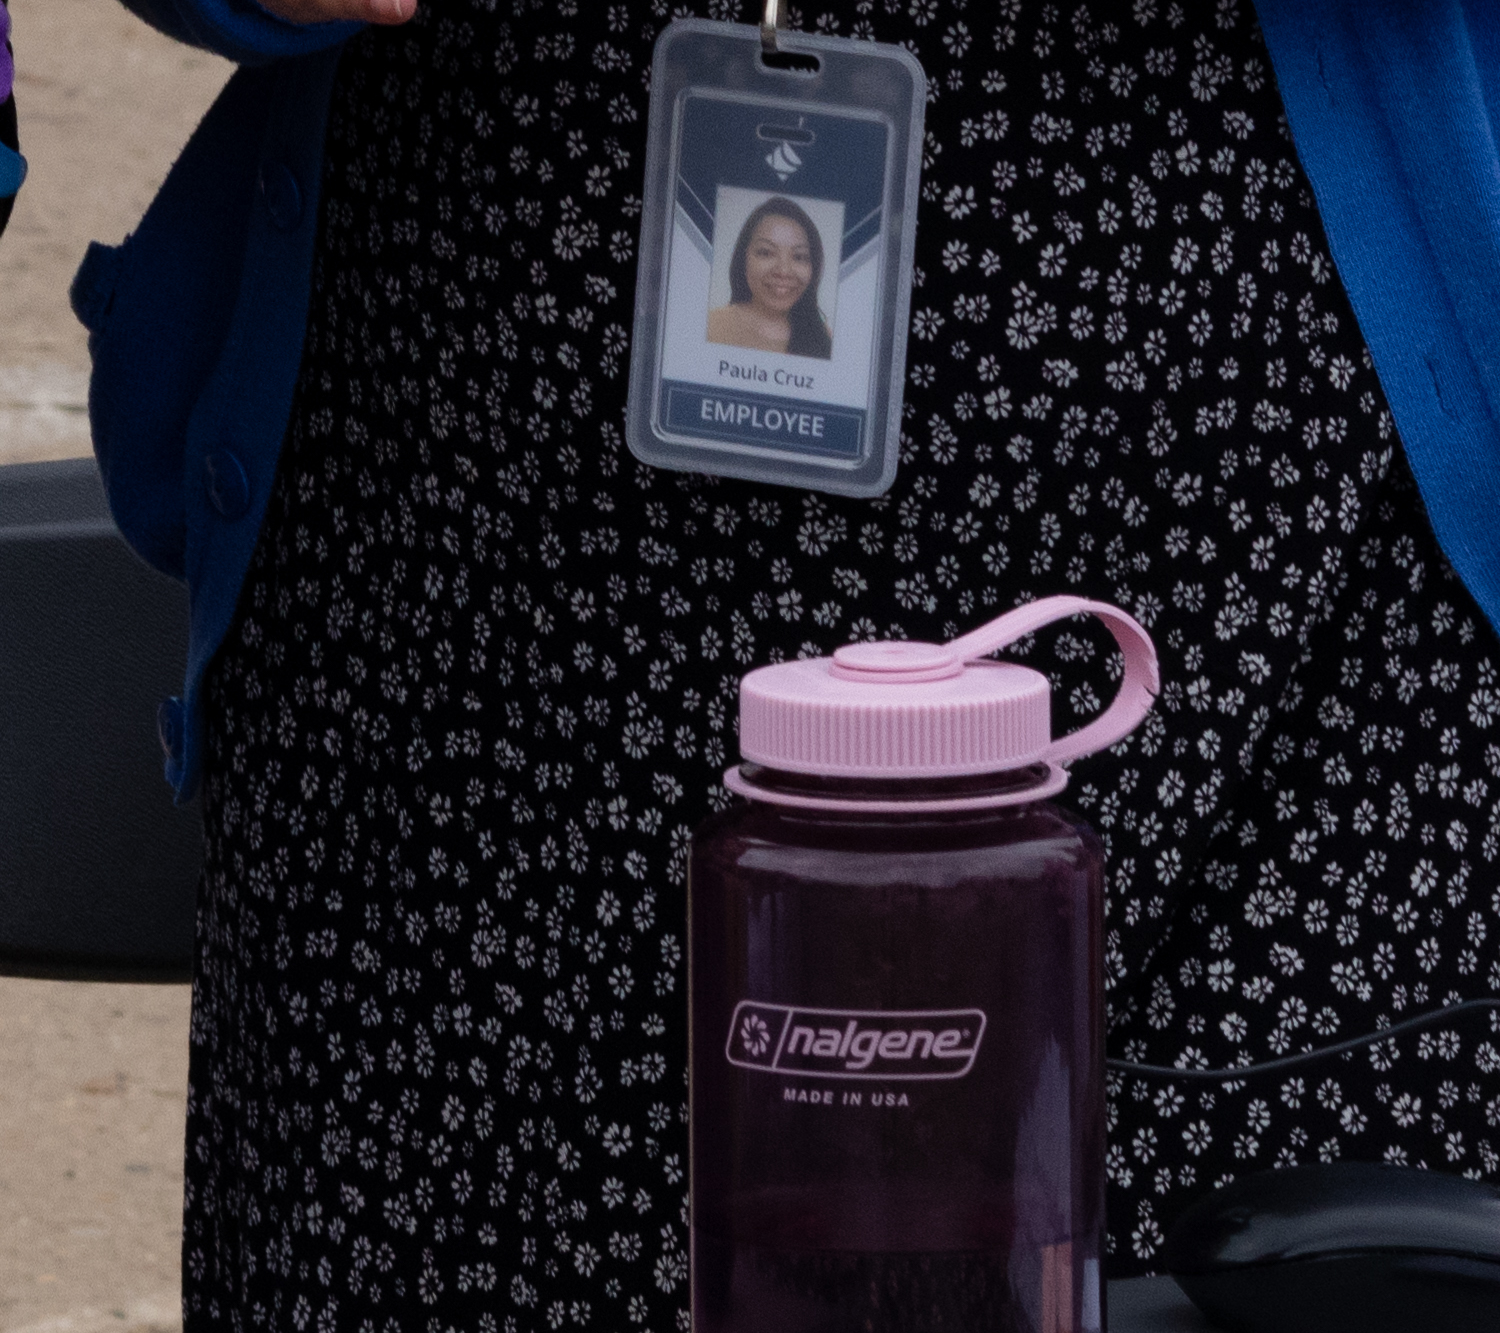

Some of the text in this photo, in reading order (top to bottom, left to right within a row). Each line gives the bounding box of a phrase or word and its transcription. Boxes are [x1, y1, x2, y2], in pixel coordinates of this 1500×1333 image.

[719, 359, 815, 389] Paula Cruz
[701, 398, 825, 438] EMPLOYEE
[783, 1086, 910, 1107] MADE IN USA
